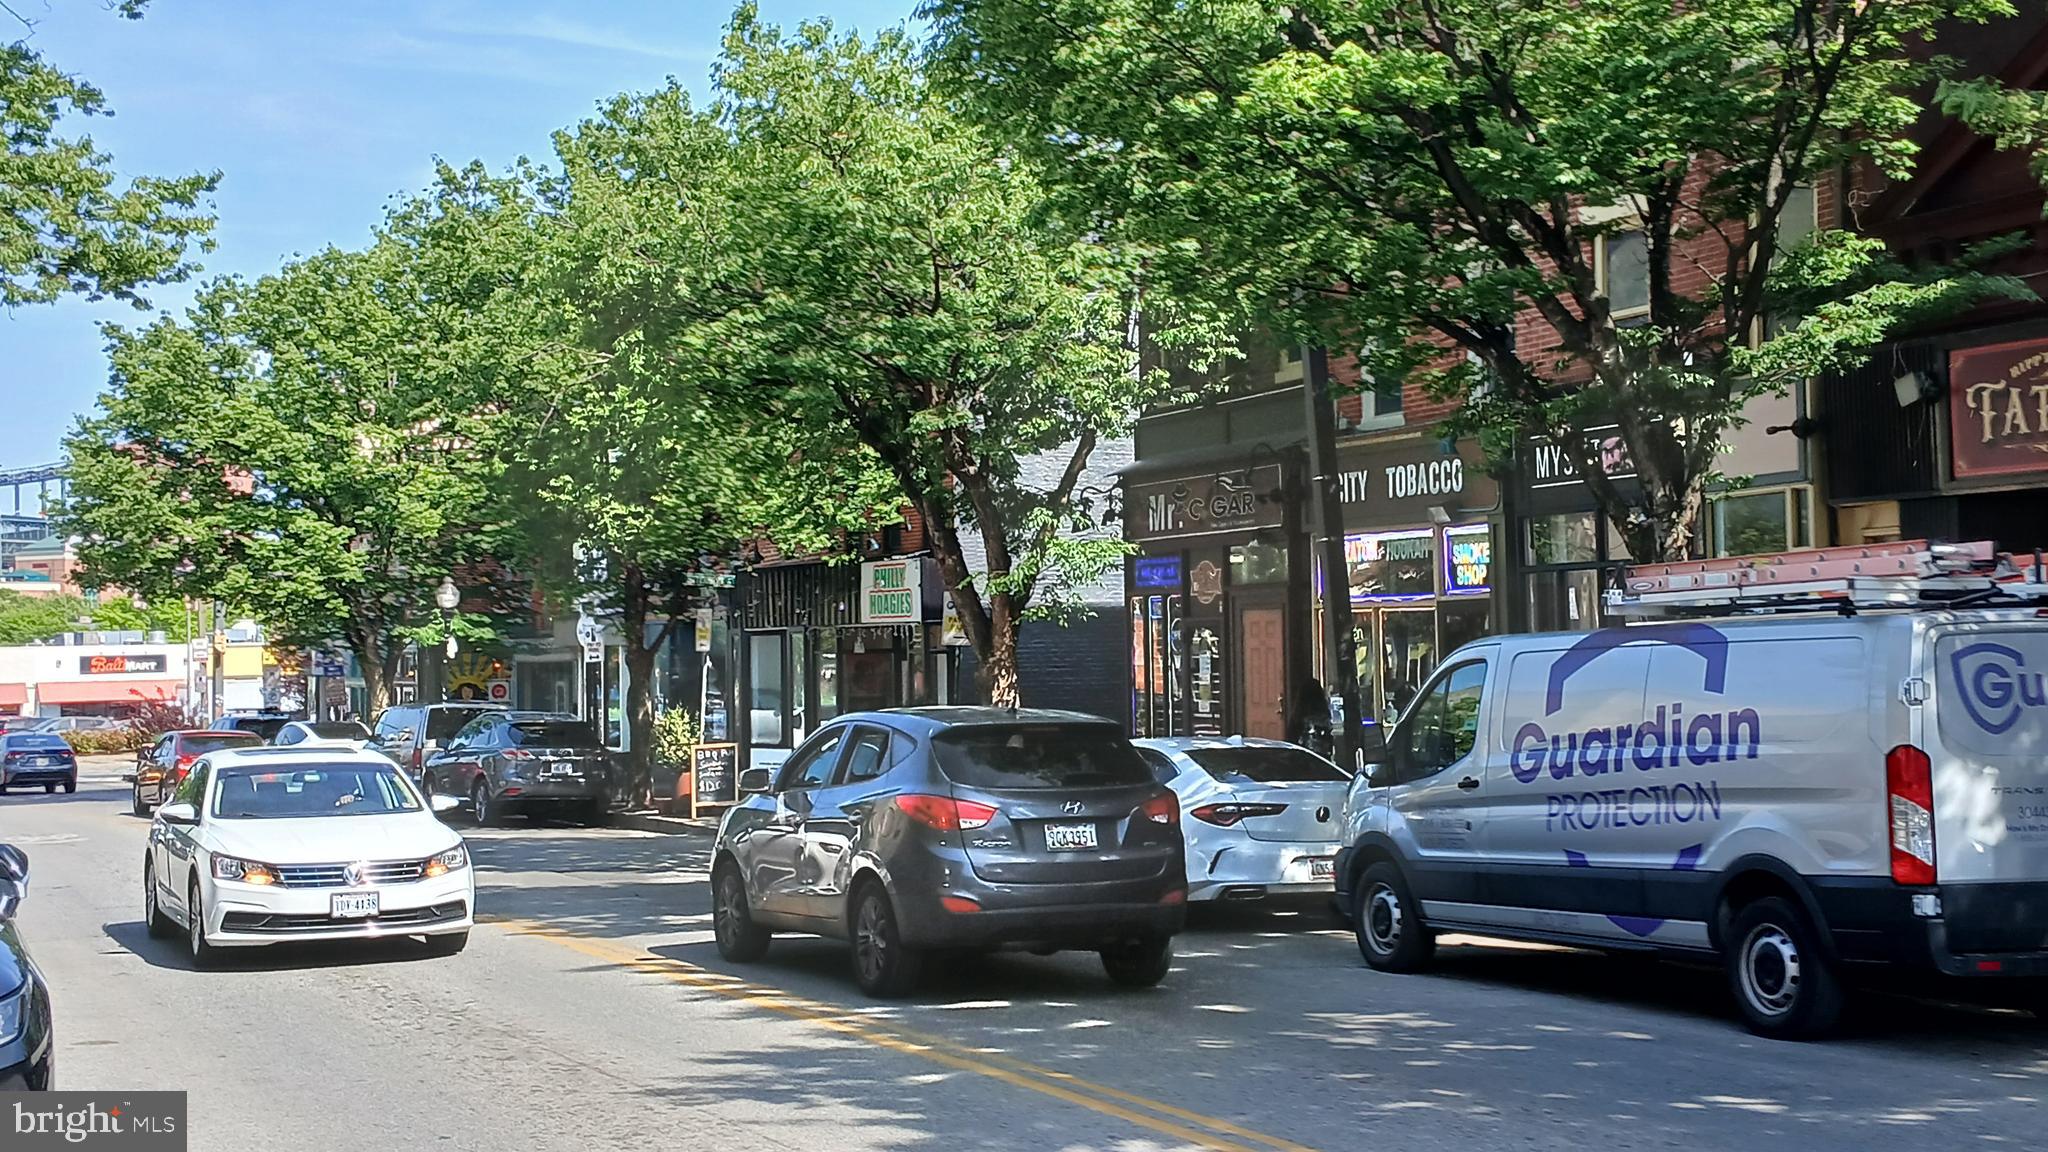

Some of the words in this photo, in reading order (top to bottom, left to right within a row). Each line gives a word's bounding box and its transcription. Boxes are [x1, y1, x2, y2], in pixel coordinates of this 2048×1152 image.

[1385, 458, 1463, 498] TOBACCO
[1148, 494, 1184, 532] Mr.
[1385, 537, 1430, 562] HOOKAH
[1452, 542, 1490, 565] SMOKE
[873, 567, 907, 589] PHILLY
[1456, 564, 1488, 586] SHOP
[869, 592, 912, 615] HOAGIES
[1973, 662, 2046, 709] Gu
[1510, 702, 1761, 784] Guardian
[1545, 780, 1721, 832] PROTECTION
